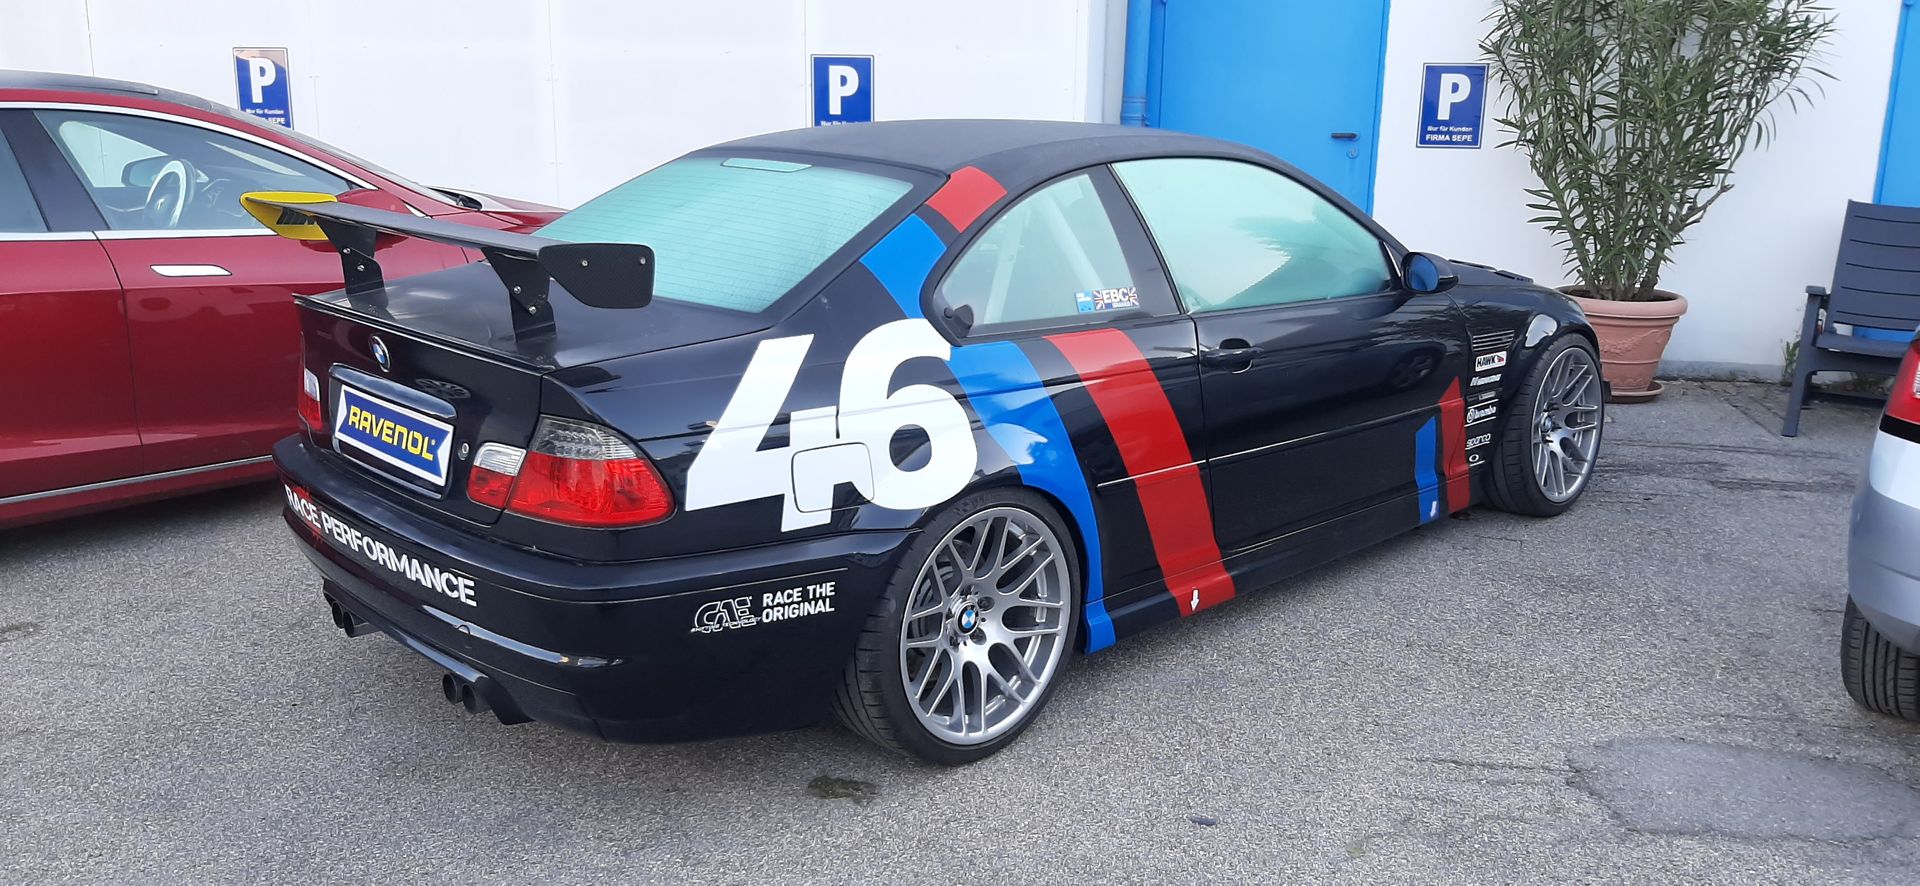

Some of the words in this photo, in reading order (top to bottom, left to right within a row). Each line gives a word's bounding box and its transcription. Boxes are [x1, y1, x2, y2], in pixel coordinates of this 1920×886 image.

[249, 57, 277, 104] P
[829, 65, 859, 115] P
[1437, 73, 1471, 120] P
[1451, 134, 1473, 142] SEPE
[1102, 288, 1129, 304] EBC
[1476, 354, 1496, 368] HAWK
[348, 405, 434, 461] RAVENOL
[685, 318, 977, 532] 46
[1466, 433, 1491, 448] sparco
[285, 484, 321, 528] RACE
[321, 511, 477, 607] PERFORMANCE
[762, 588, 803, 607] RACE
[806, 581, 836, 599] THE
[762, 598, 835, 623] ORIGINAL
